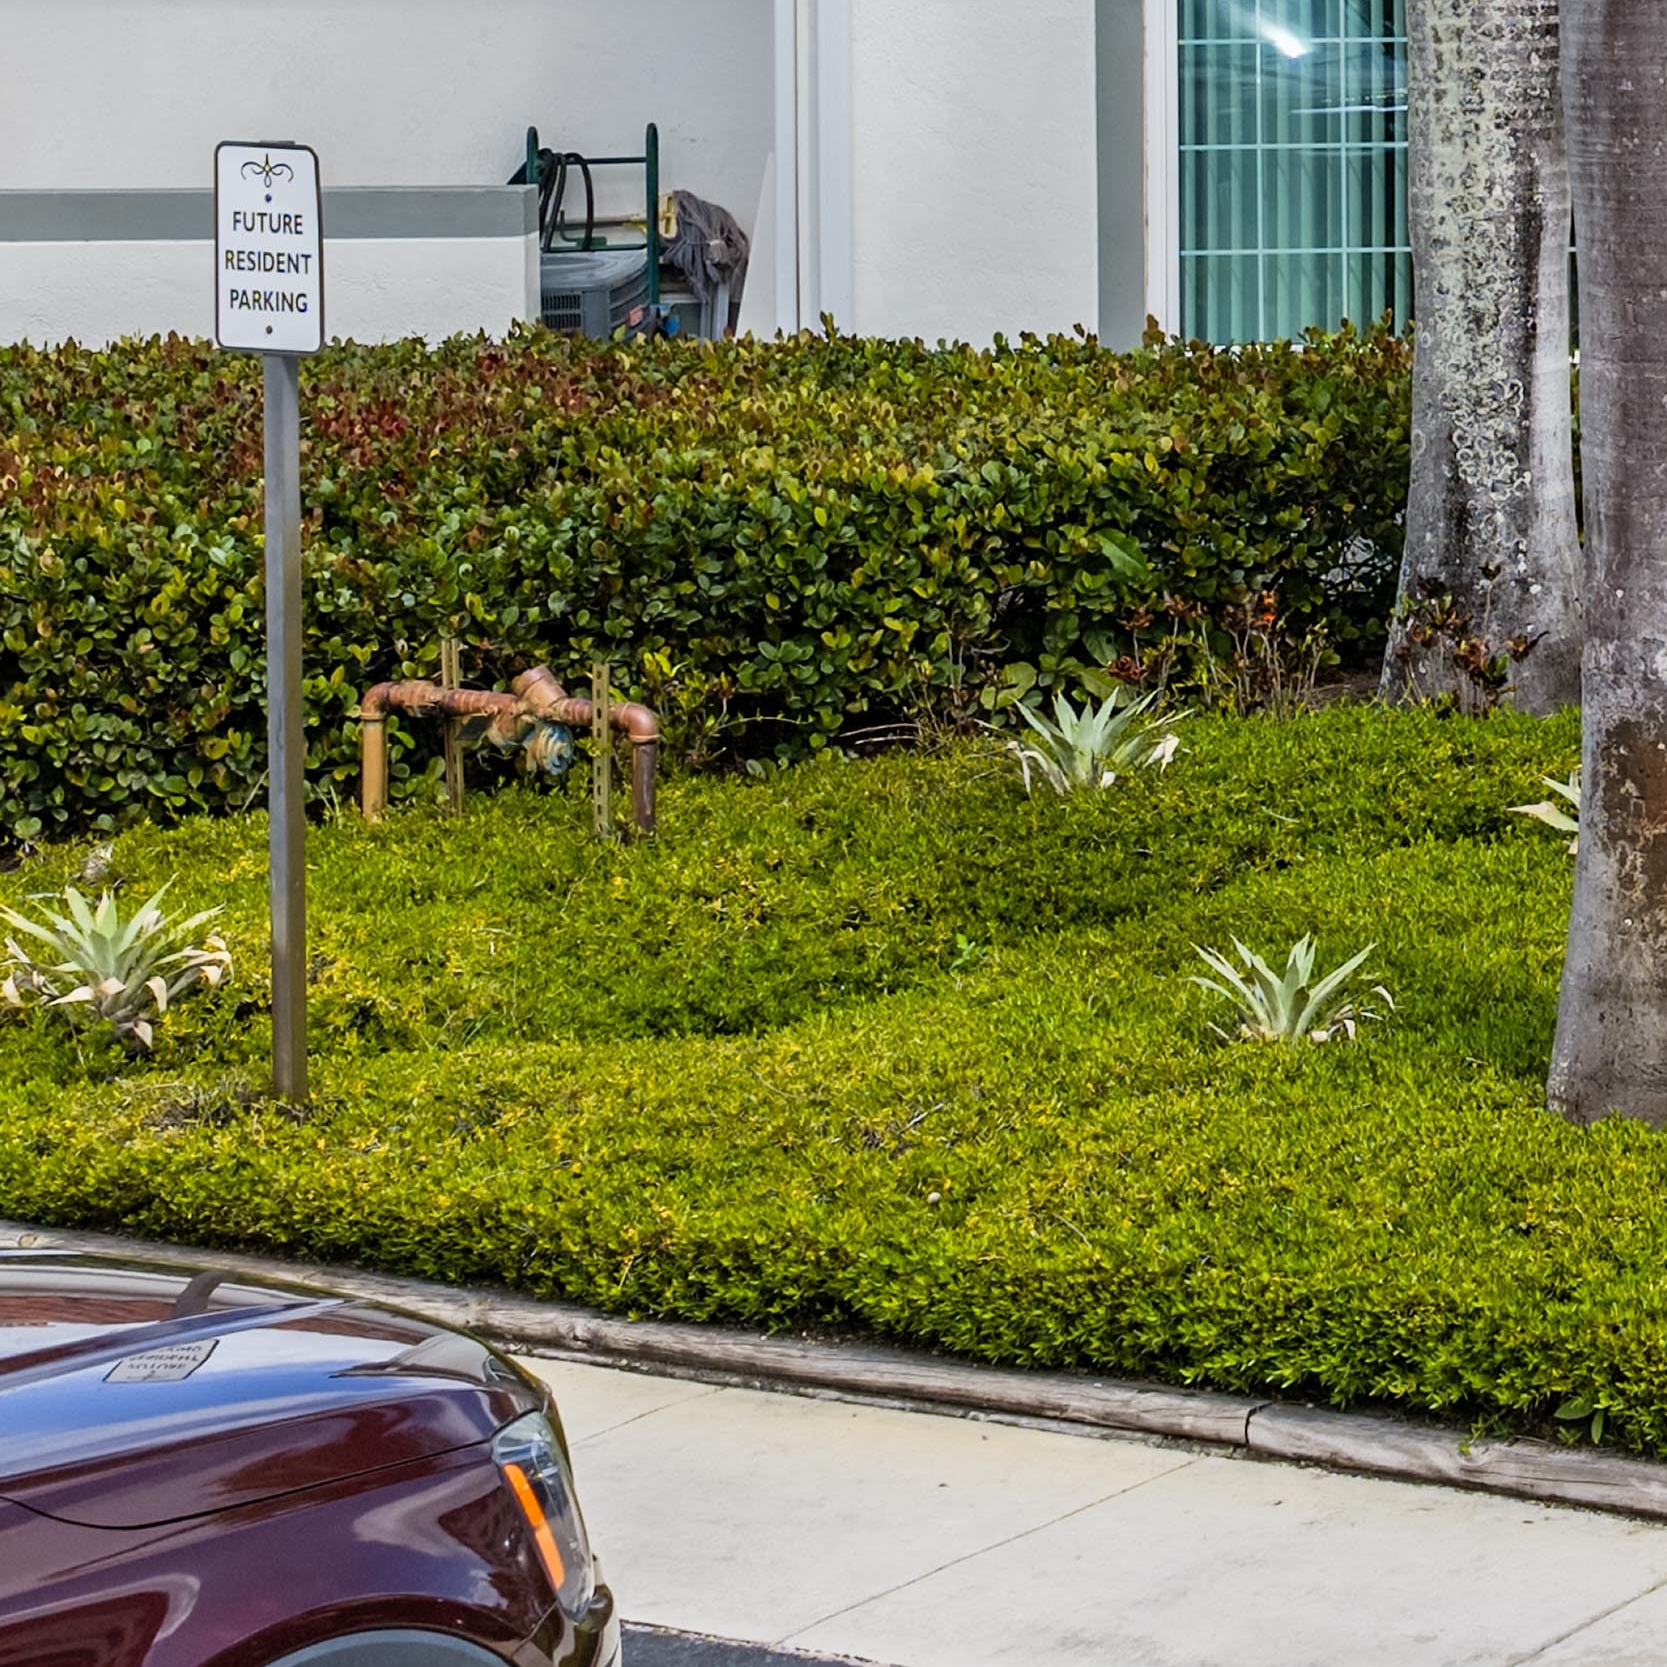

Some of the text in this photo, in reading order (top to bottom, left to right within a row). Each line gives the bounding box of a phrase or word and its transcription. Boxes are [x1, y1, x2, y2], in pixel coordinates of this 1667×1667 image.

[232, 210, 303, 236] FUTURE
[225, 249, 312, 275] RESIDENT
[229, 288, 308, 313] PARKING
